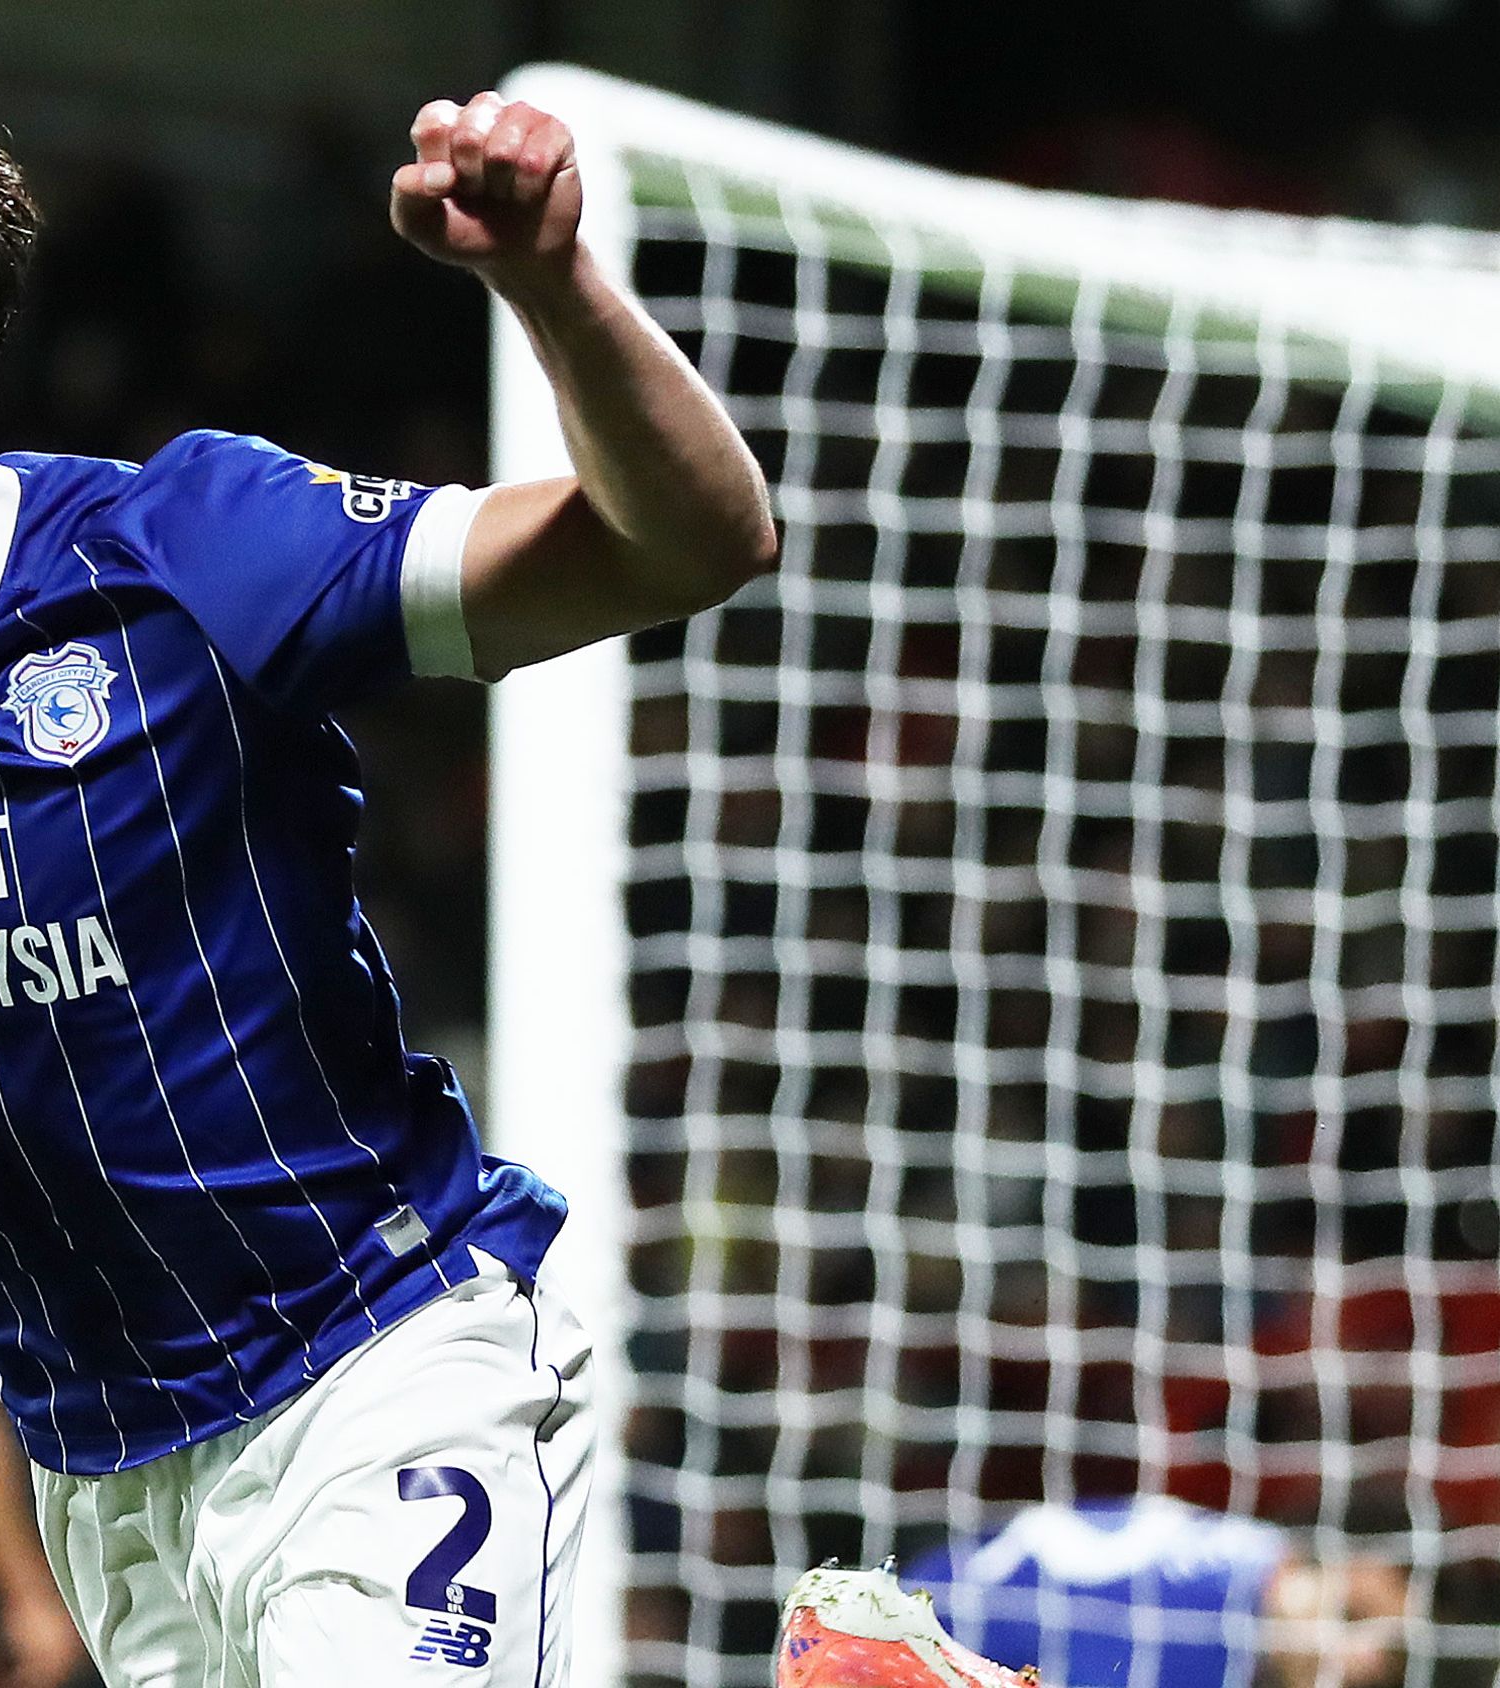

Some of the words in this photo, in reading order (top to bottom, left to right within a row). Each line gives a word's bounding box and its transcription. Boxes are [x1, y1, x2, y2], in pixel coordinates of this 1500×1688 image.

[20, 673, 56, 696] CARDIFF
[58, 669, 79, 678] CITY
[80, 669, 92, 678] FC
[397, 1467, 496, 1624] 2
